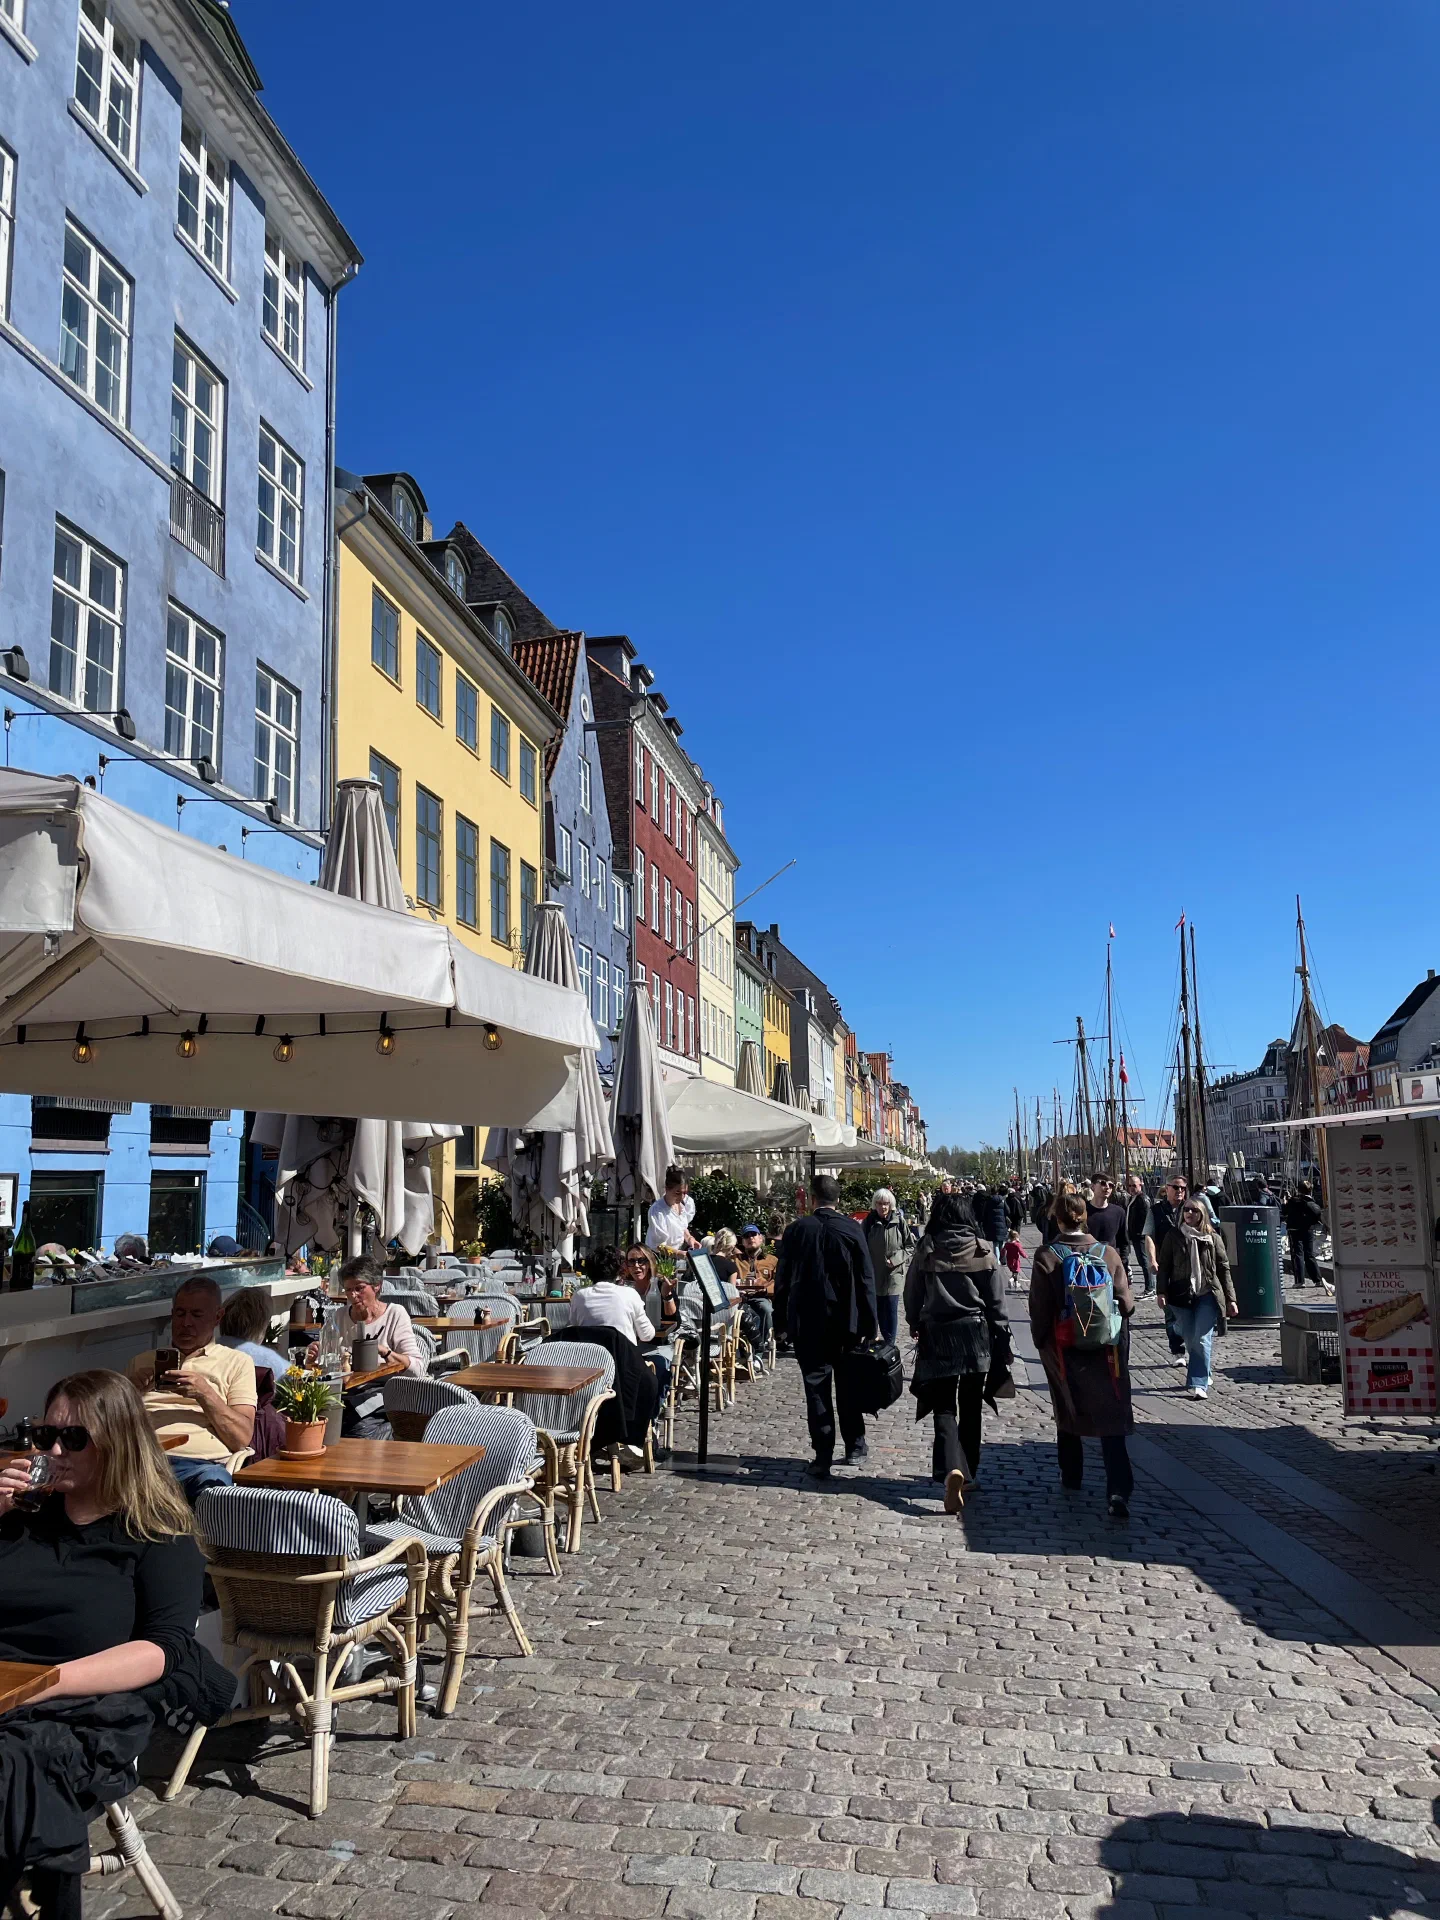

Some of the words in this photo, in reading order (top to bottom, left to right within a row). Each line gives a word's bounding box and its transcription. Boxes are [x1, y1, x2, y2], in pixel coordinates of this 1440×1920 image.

[1245, 1229, 1268, 1237] Affald
[1363, 1271, 1401, 1279] KÆMPE
[1360, 1280, 1405, 1288] HOTDOG
